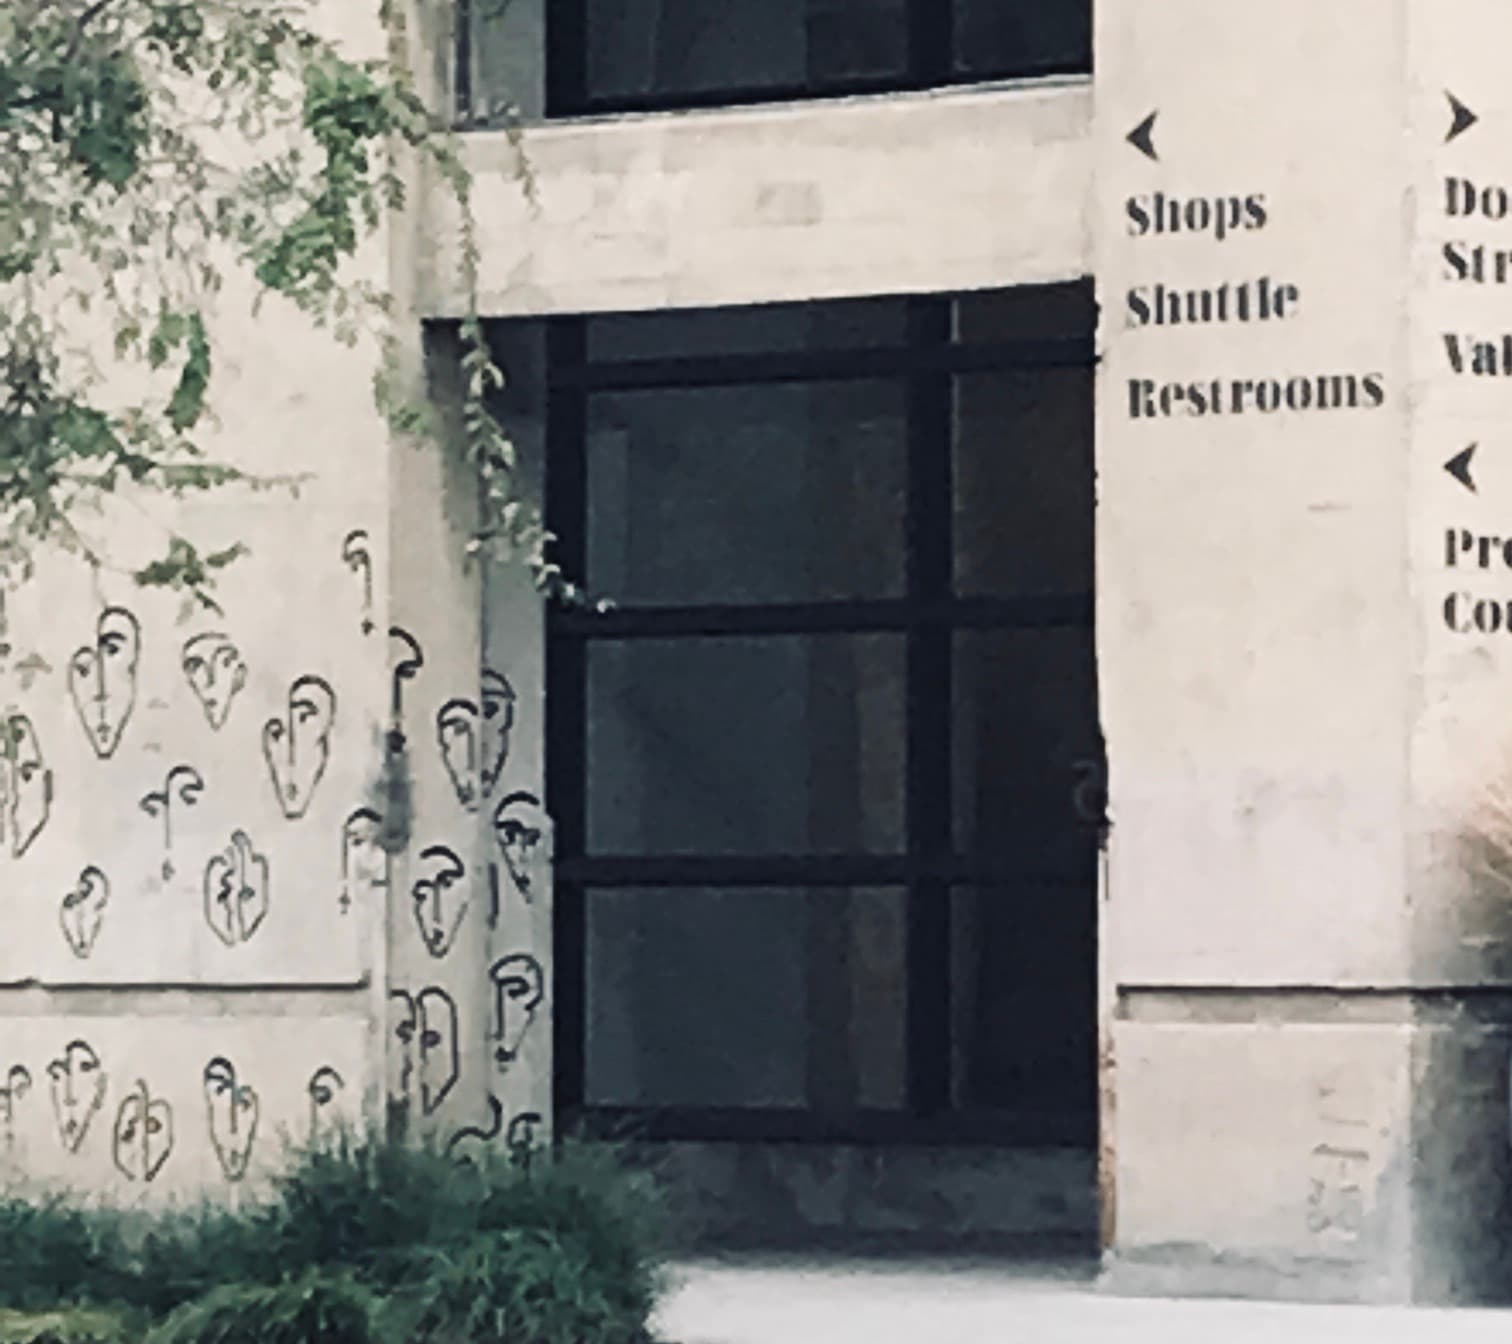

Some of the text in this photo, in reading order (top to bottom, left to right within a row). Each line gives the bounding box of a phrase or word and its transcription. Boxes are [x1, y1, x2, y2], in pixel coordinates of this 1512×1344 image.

[1125, 192, 1267, 241] Shops
[1125, 276, 1299, 329] Shuttle
[1126, 372, 1384, 419] Restrooms
